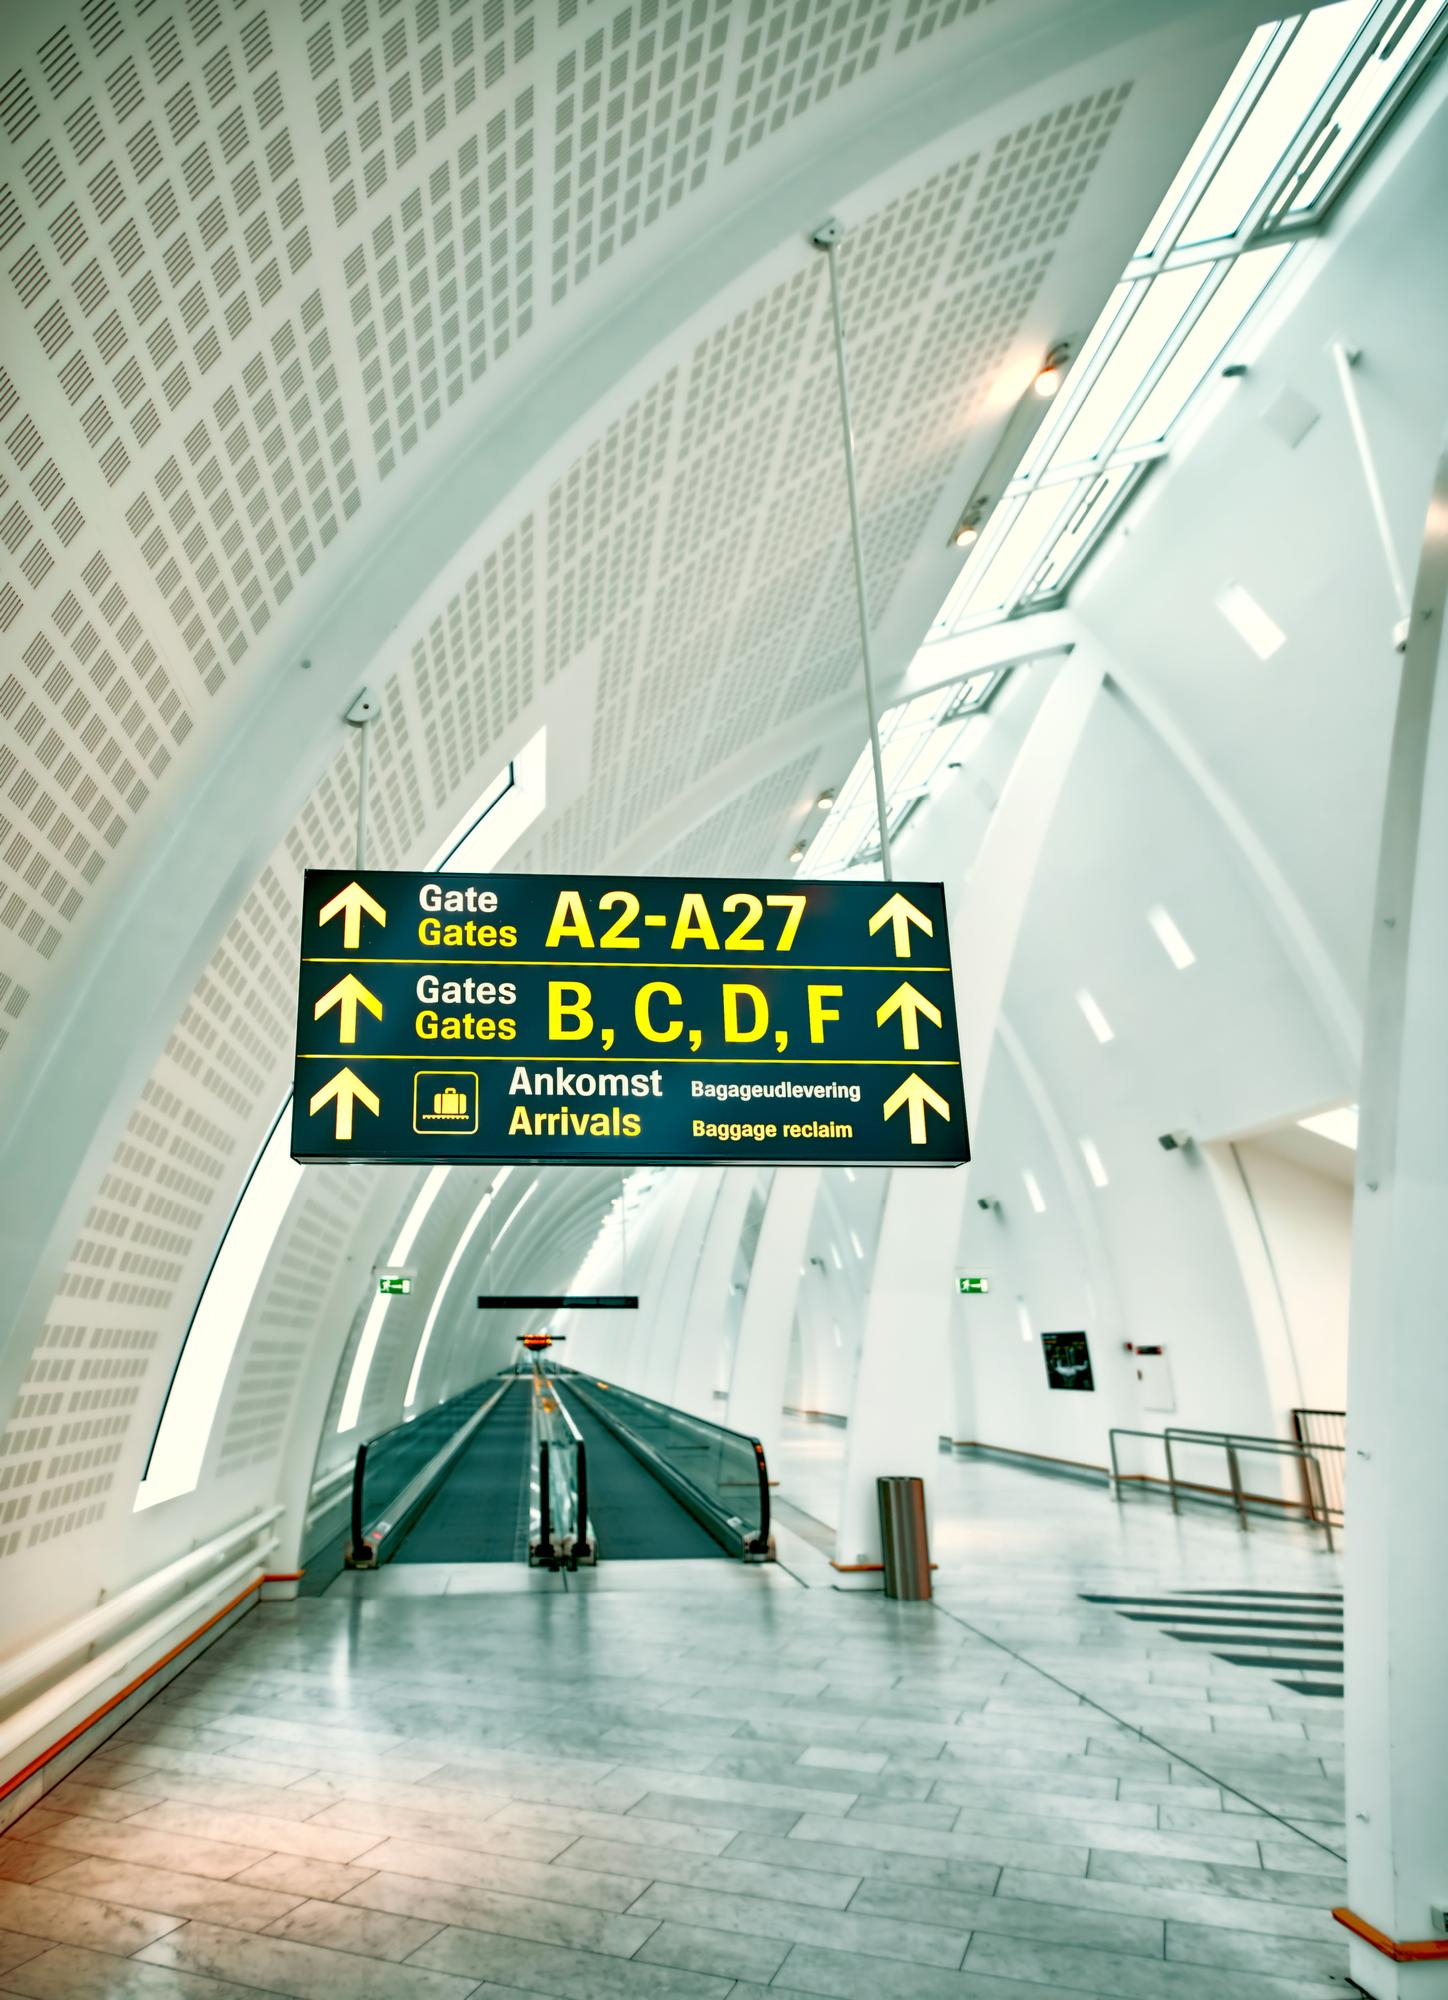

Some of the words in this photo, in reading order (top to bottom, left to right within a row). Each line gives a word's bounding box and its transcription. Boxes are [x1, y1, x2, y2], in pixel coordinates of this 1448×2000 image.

[419, 884, 497, 912] Gate
[419, 918, 517, 947] Gates
[545, 891, 806, 951] A2-A27
[417, 975, 516, 1004] Gates
[416, 1010, 516, 1040] Gates
[549, 981, 614, 1050] B,
[635, 982, 701, 1052] C,
[723, 984, 787, 1052] D,
[808, 985, 843, 1043] F
[509, 1067, 662, 1097] Ankomst
[692, 1081, 860, 1102] Bagageudlevering
[509, 1106, 641, 1136] Arrivals
[693, 1120, 777, 1141] Baggage
[783, 1121, 852, 1137] reclaim
